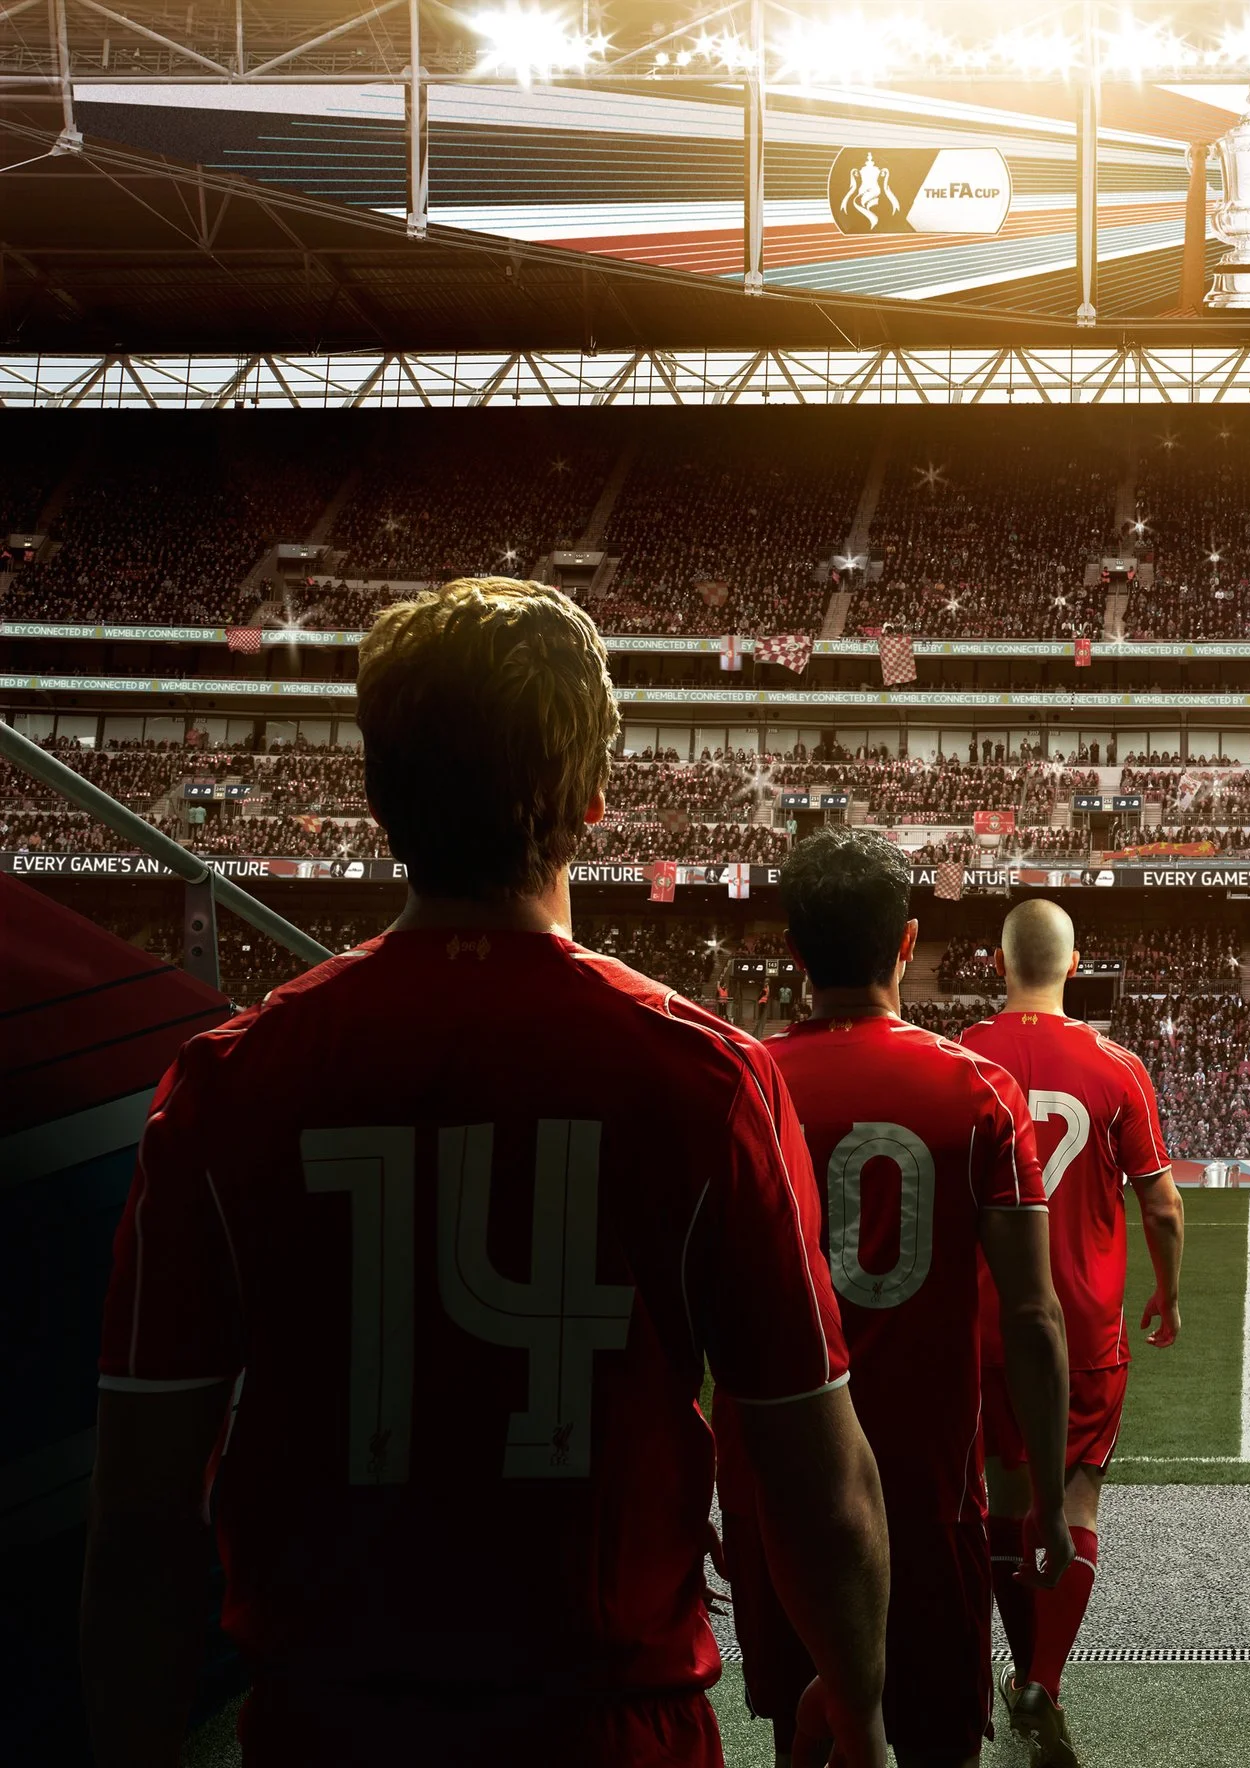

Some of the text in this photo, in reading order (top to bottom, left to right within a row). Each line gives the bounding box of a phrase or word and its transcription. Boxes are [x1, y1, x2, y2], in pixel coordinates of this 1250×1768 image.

[924, 183, 1000, 199] THE FA CUP
[27, 626, 81, 636] CONNECTED
[82, 628, 94, 636] BY
[104, 628, 214, 639] WEMBLEY CONNECTED BY
[323, 633, 335, 642] BY
[632, 641, 685, 649] CONNECTED
[952, 644, 1063, 654] WEMBLEY CONNECTED BY
[1173, 646, 1185, 654] BY
[1195, 646, 1237, 654] WEMBLEY
[17, 679, 30, 687] BY
[40, 679, 151, 690] WEMBLEY CONNECTED BY
[161, 682, 272, 692] WEMBLEY CONNECTED BY
[282, 684, 325, 693] WEMBLEY
[624, 691, 636, 699] BY
[647, 692, 758, 701] WEMBLEY CONNECTED BY
[768, 693, 879, 702] WEMBLEY CONNECTED BY
[890, 694, 1000, 703] WEMBLEY CONNECTED BY
[1012, 695, 1054, 704] WEMBLEY
[1110, 696, 1122, 704] BY
[1134, 696, 1245, 705] WEMBLEY CONNECTED BY
[13, 856, 66, 871] EVERY
[71, 857, 131, 872] GAME'S
[135, 858, 159, 873] AN
[568, 866, 643, 882] VENTURE
[1143, 872, 1196, 885] EVERY
[300, 1118, 636, 1485] 14
